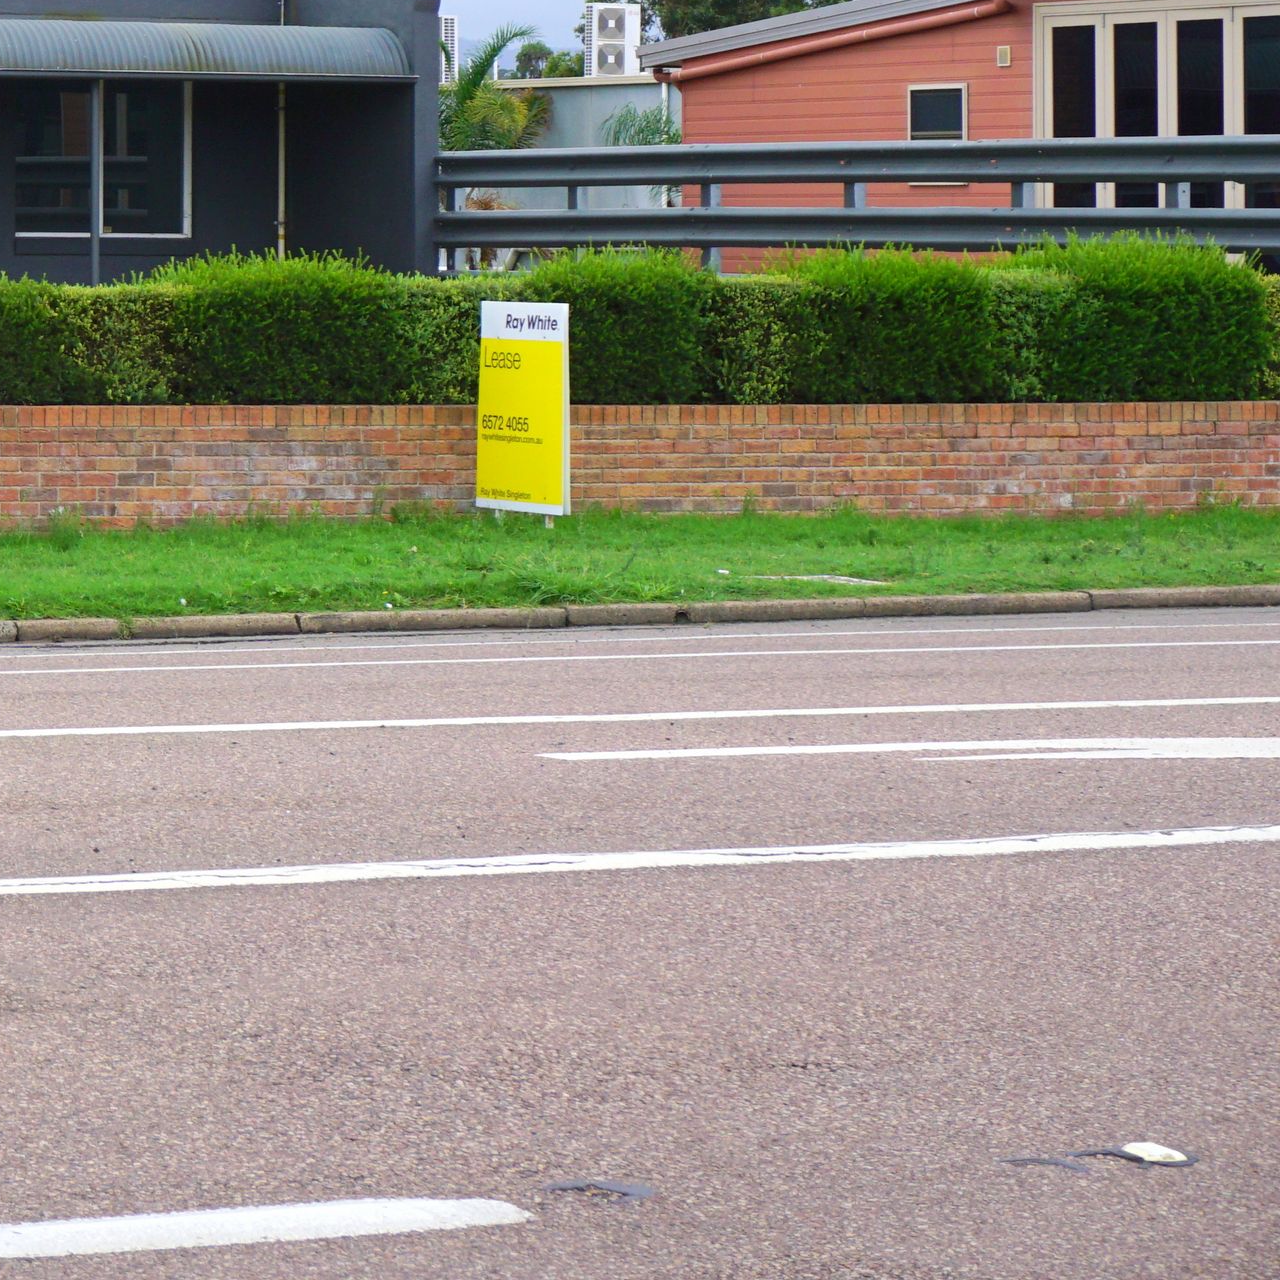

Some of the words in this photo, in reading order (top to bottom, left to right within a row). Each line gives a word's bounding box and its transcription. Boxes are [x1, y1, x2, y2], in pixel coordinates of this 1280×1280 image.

[505, 314, 525, 332] Ray
[527, 315, 558, 331] White
[484, 345, 521, 370] Lease
[482, 414, 504, 430] 6572
[506, 416, 529, 432] 4055
